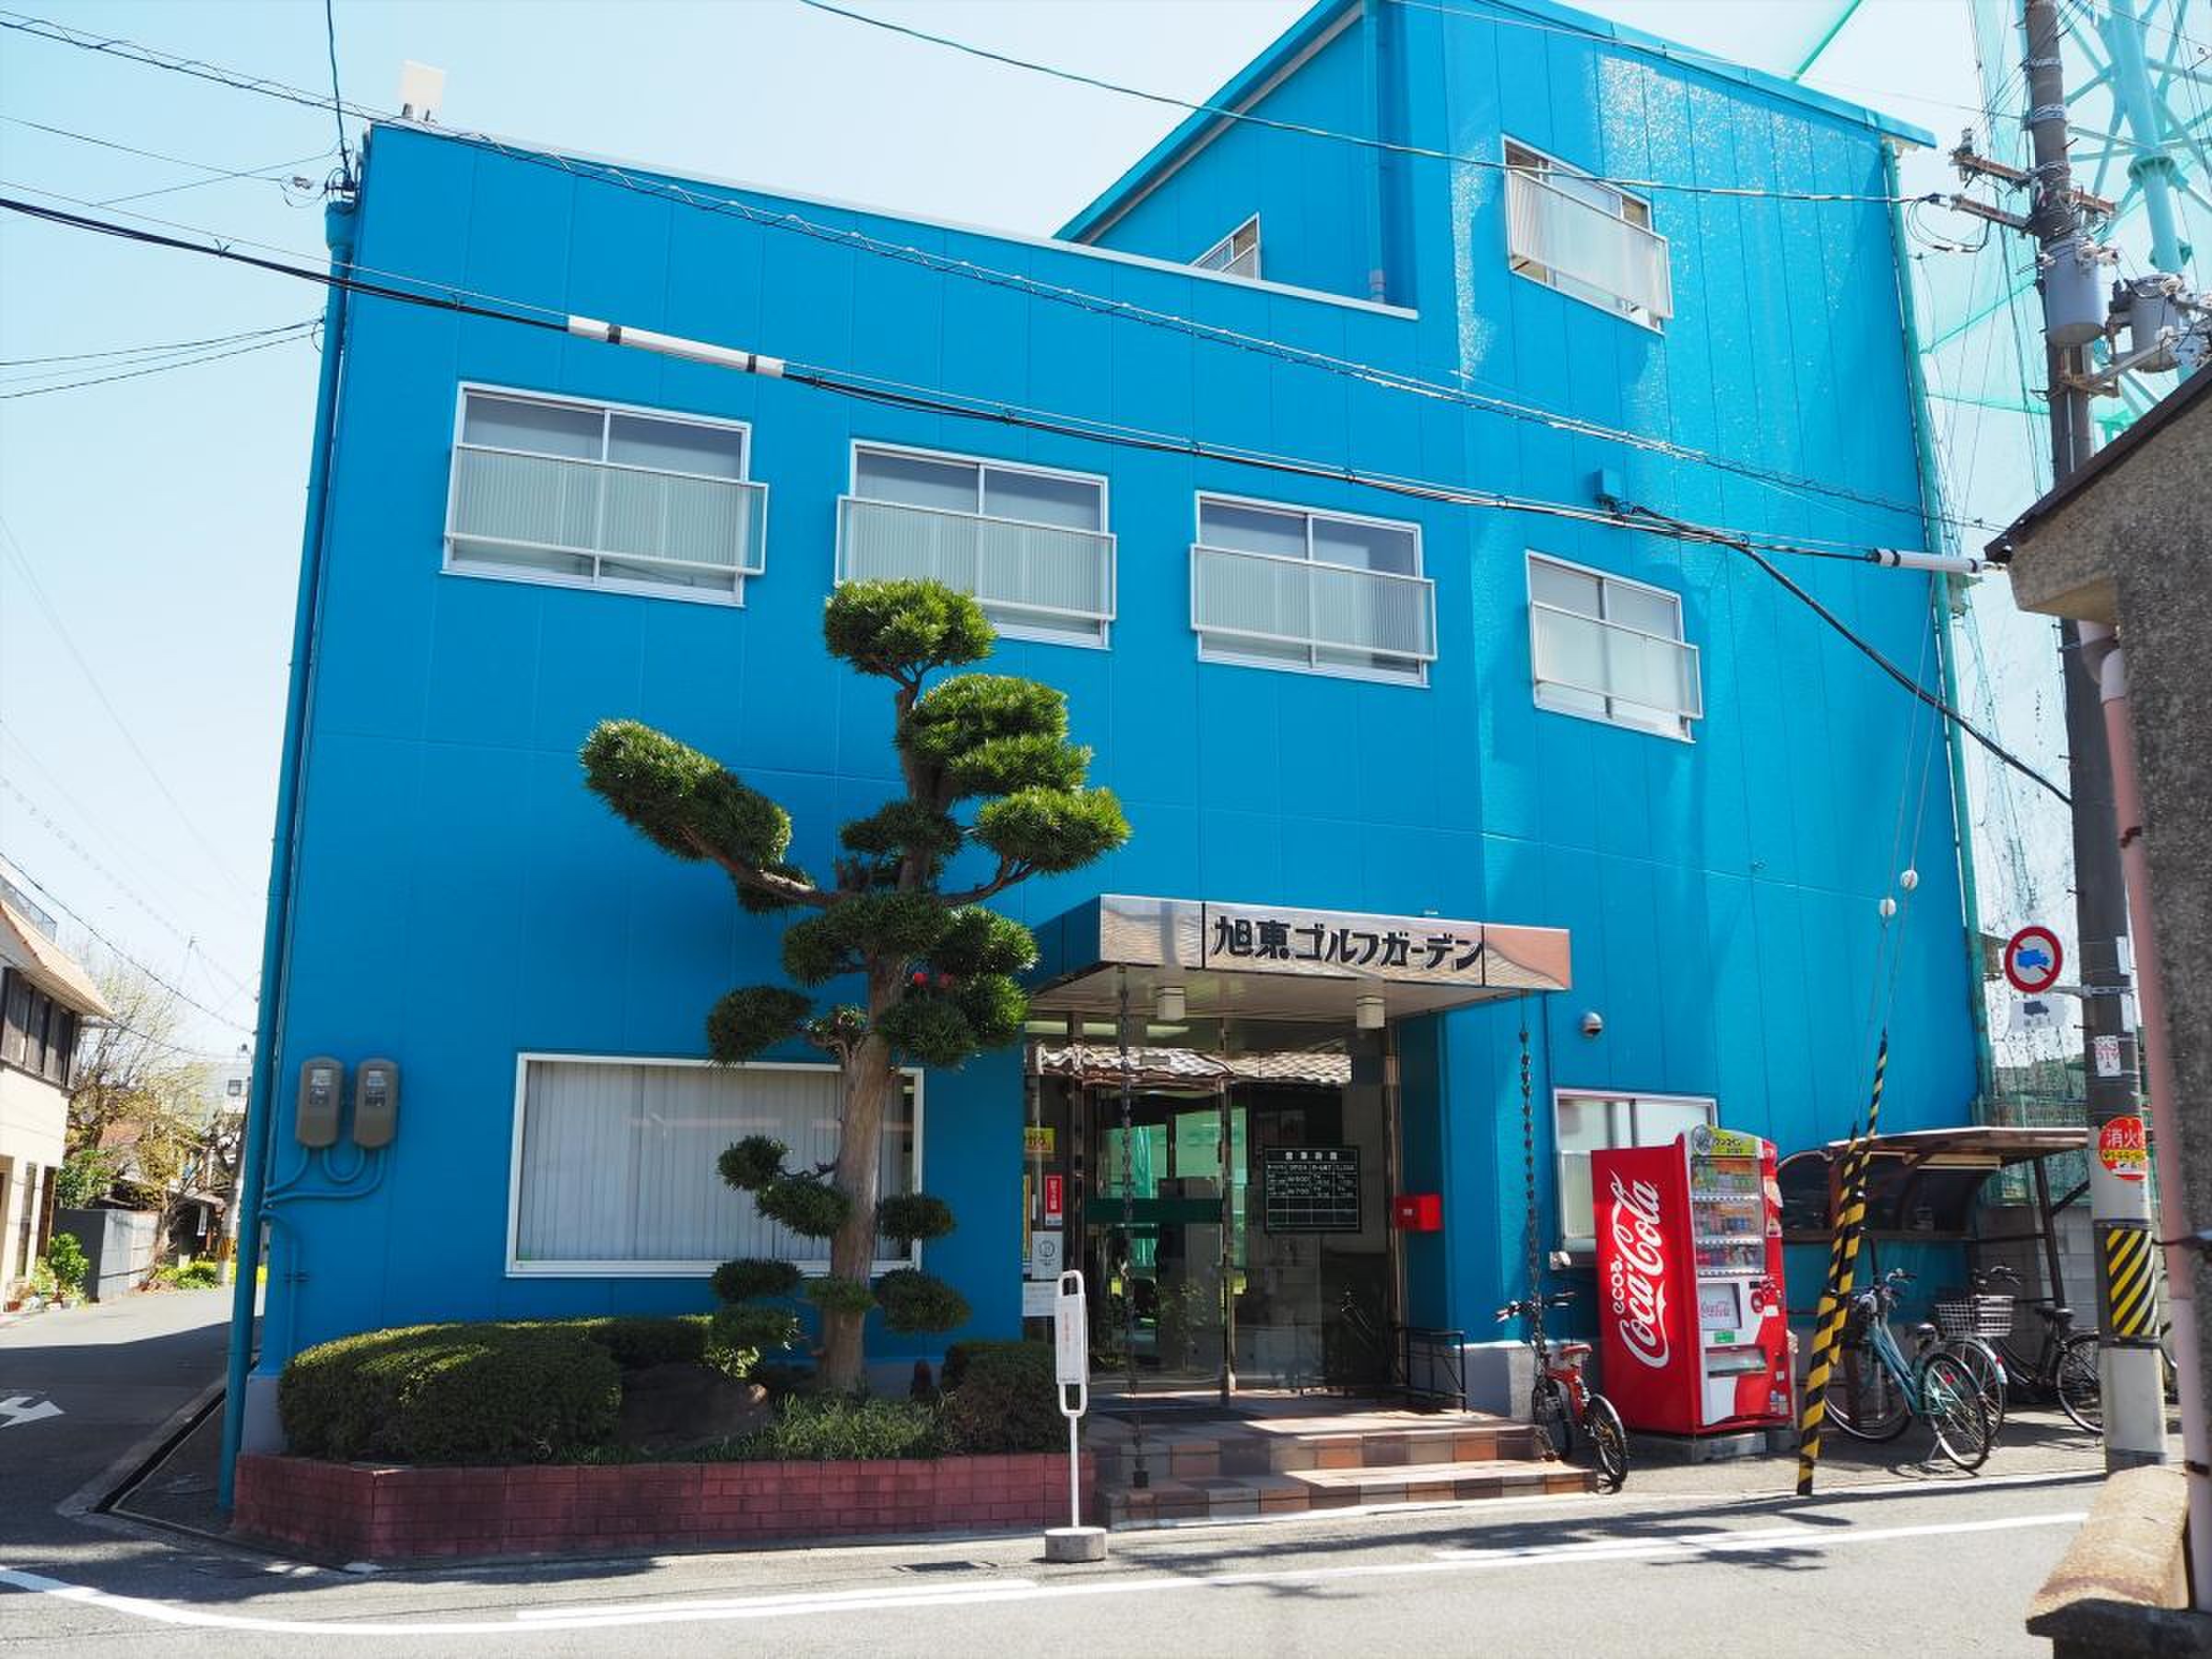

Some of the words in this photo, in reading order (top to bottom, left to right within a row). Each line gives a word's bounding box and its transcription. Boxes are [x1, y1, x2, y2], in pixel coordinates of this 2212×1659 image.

[1214, 915, 1483, 971] 旭東ゴルフガーデン
[2107, 1127, 2146, 1148] 消火
